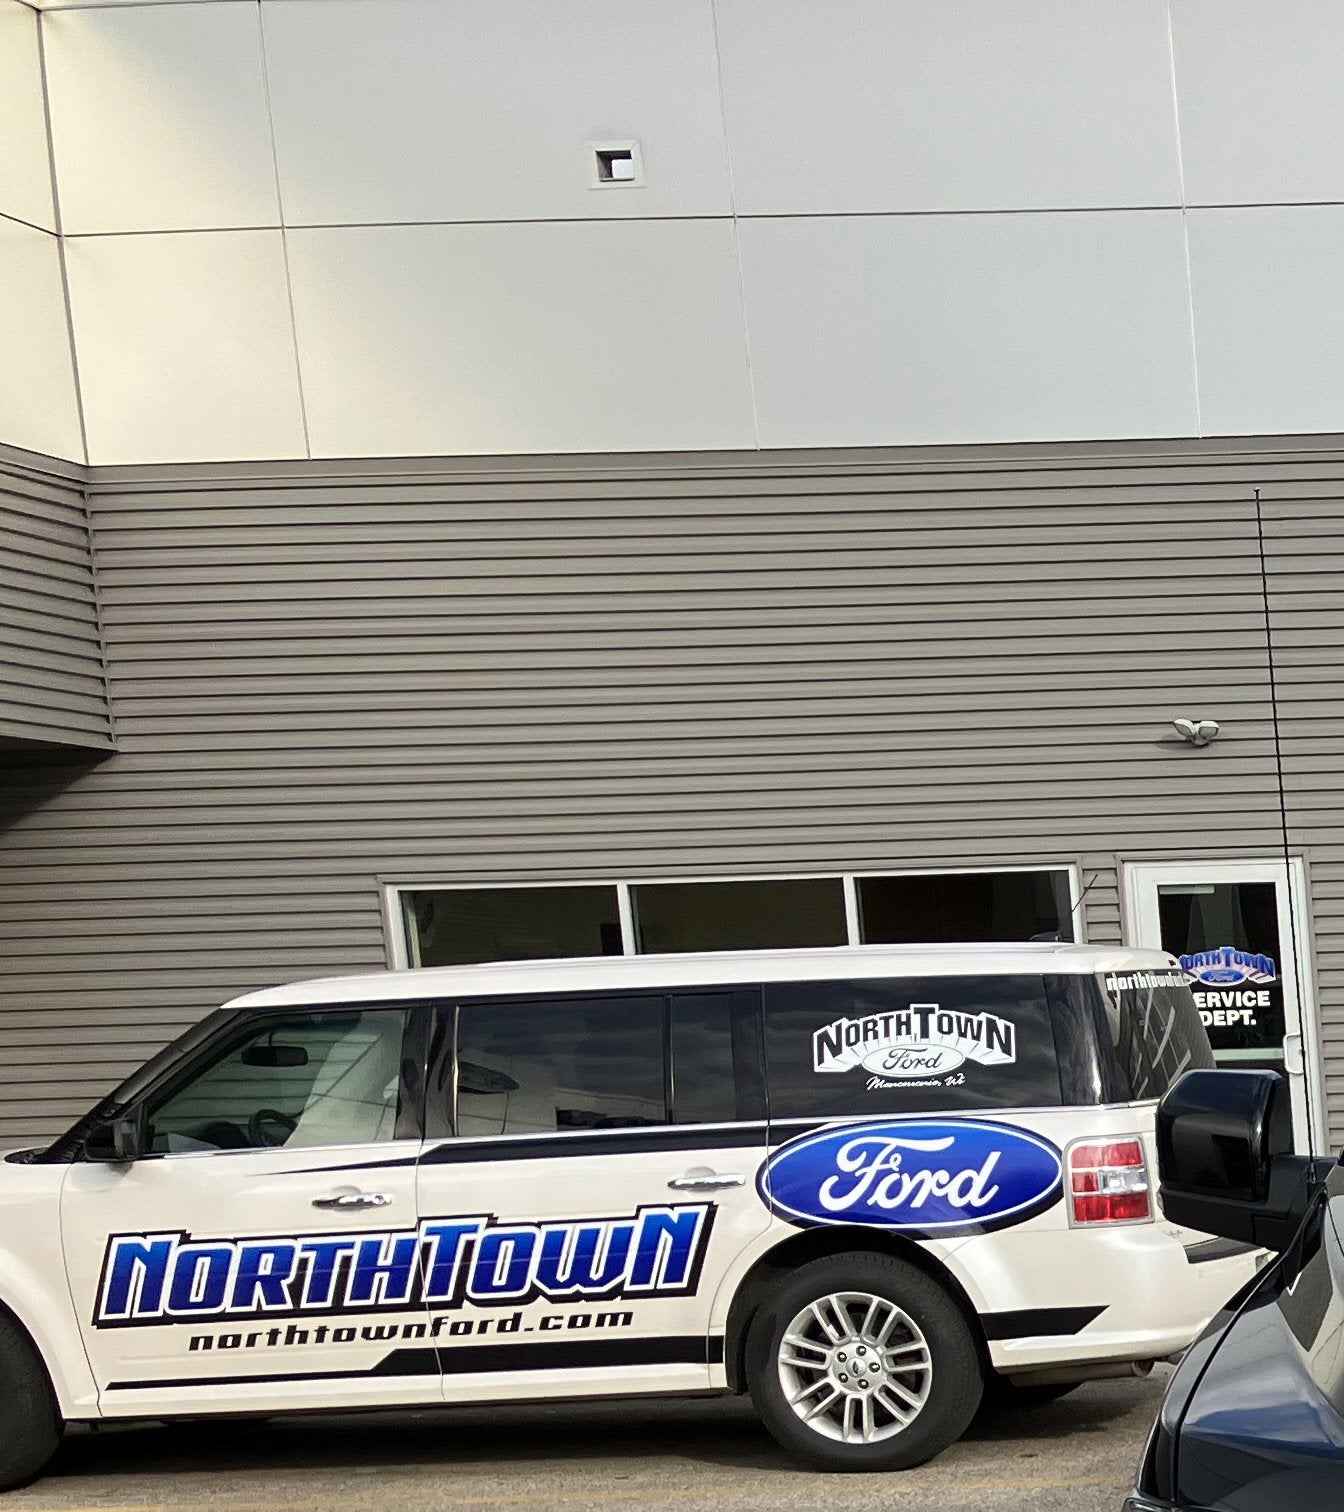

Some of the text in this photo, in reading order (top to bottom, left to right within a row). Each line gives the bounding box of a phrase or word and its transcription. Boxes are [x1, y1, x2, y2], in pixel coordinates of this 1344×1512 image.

[1180, 947, 1275, 980] ORTHTOWN
[1193, 991, 1271, 1008] ERVICE
[1200, 1009, 1257, 1026] DEPT.
[814, 1004, 1015, 1071] NORTHTOWN
[882, 1047, 944, 1070] Ford
[818, 1135, 1002, 1212] Ford
[95, 1203, 716, 1328] NORTHTOWN
[188, 1311, 634, 1352] northtownford.com
